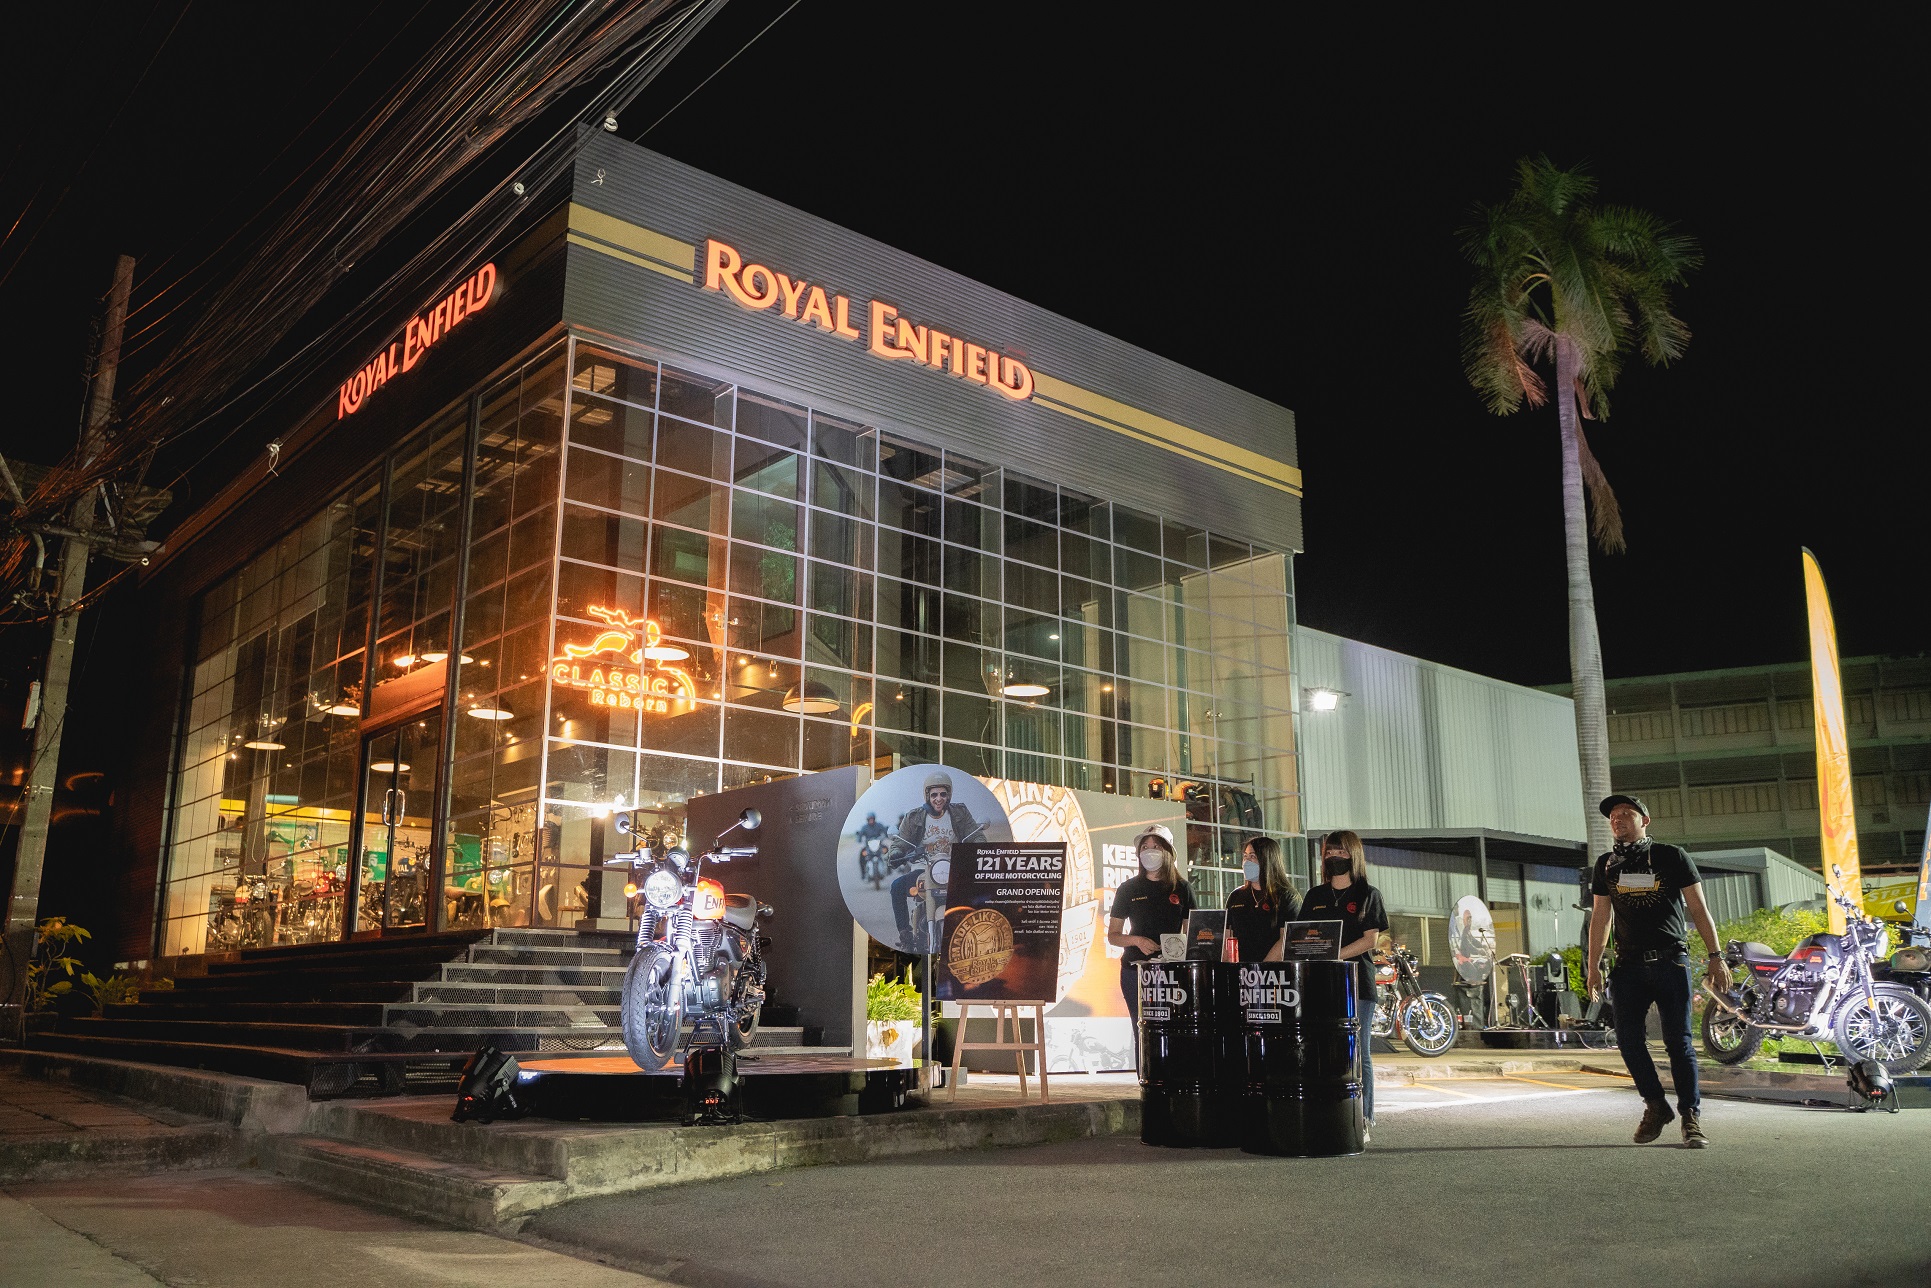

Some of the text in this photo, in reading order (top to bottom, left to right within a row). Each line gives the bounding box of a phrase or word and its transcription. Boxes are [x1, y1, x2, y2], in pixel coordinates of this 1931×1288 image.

[702, 238, 1034, 401] ROYAL ENFIELD
[337, 262, 497, 421] ROYAL ENFIELD
[552, 663, 669, 697] CLASSIC
[591, 688, 668, 713] Reborn
[996, 848, 1019, 856] ENFIELD
[1103, 844, 1140, 867] KEE
[976, 857, 1063, 871] 121 YEARS
[1005, 872, 1062, 880] MOTORCYCLING
[996, 888, 1061, 896] GRAND OPENING
[951, 921, 971, 958] MADE
[972, 911, 997, 925] LIKE
[1240, 967, 1290, 987] ROYAL
[1141, 987, 1187, 1005] NFIELD
[1239, 988, 1300, 1007] ENFIELD
